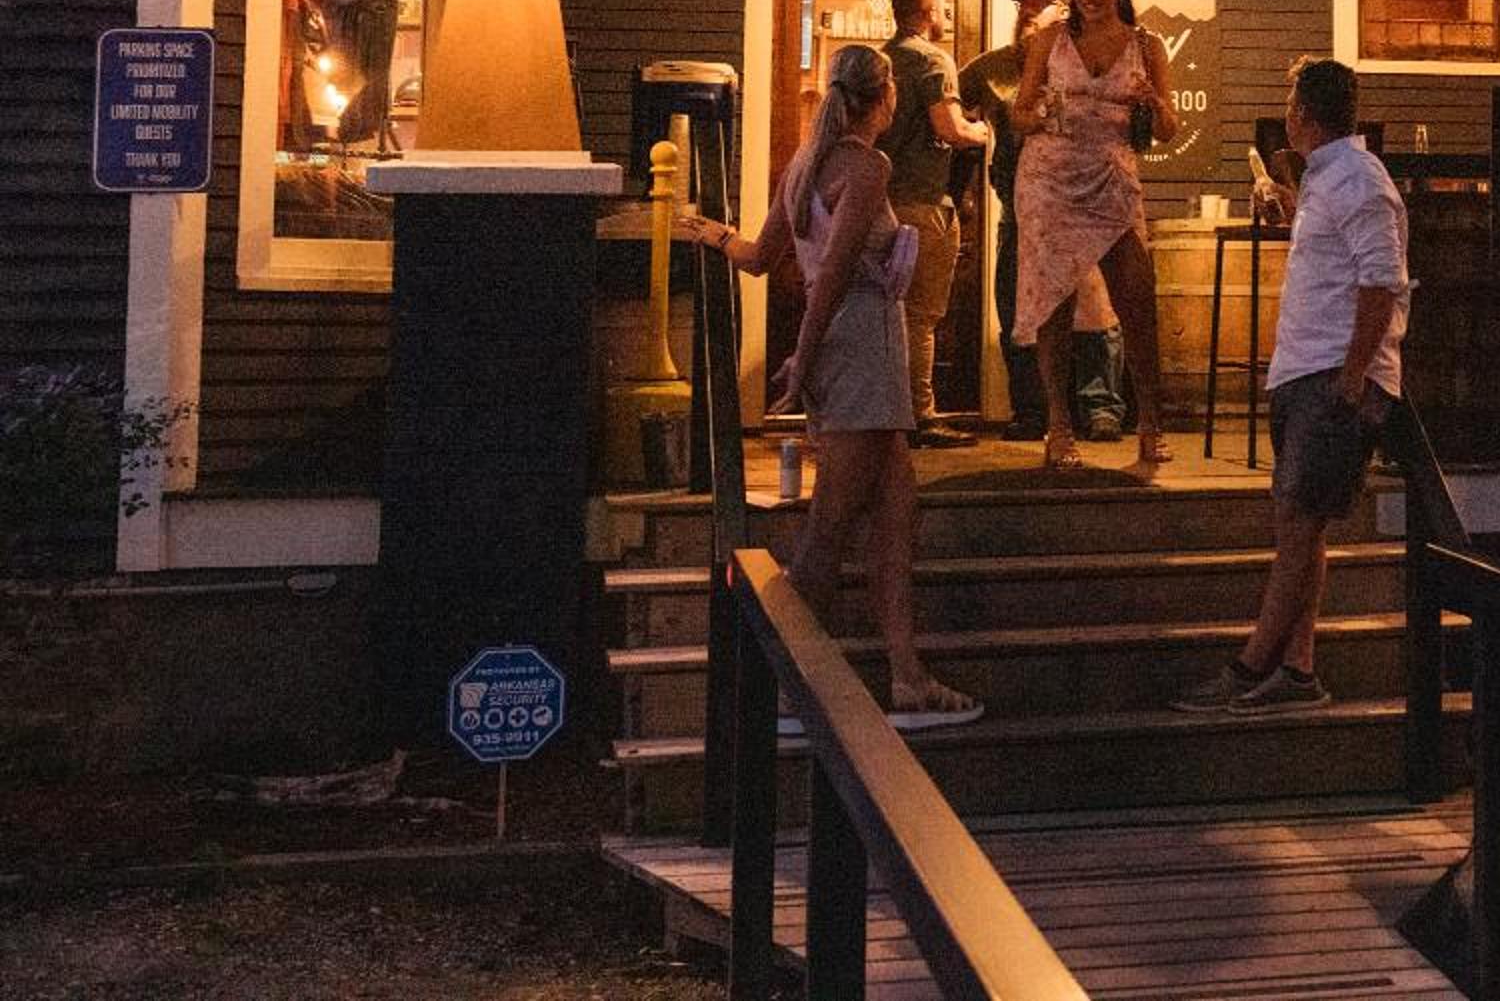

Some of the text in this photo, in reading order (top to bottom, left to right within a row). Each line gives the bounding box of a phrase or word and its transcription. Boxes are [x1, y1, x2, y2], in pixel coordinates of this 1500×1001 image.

[118, 42, 195, 58] PARKING SPACE
[133, 84, 177, 99] FOR OUR
[111, 104, 199, 120] LIMITED MOBILITY
[135, 125, 173, 140] GUESTS
[126, 152, 181, 167] THANK YOU
[489, 678, 556, 691] ARKANSAS
[488, 694, 547, 707] SECURITY
